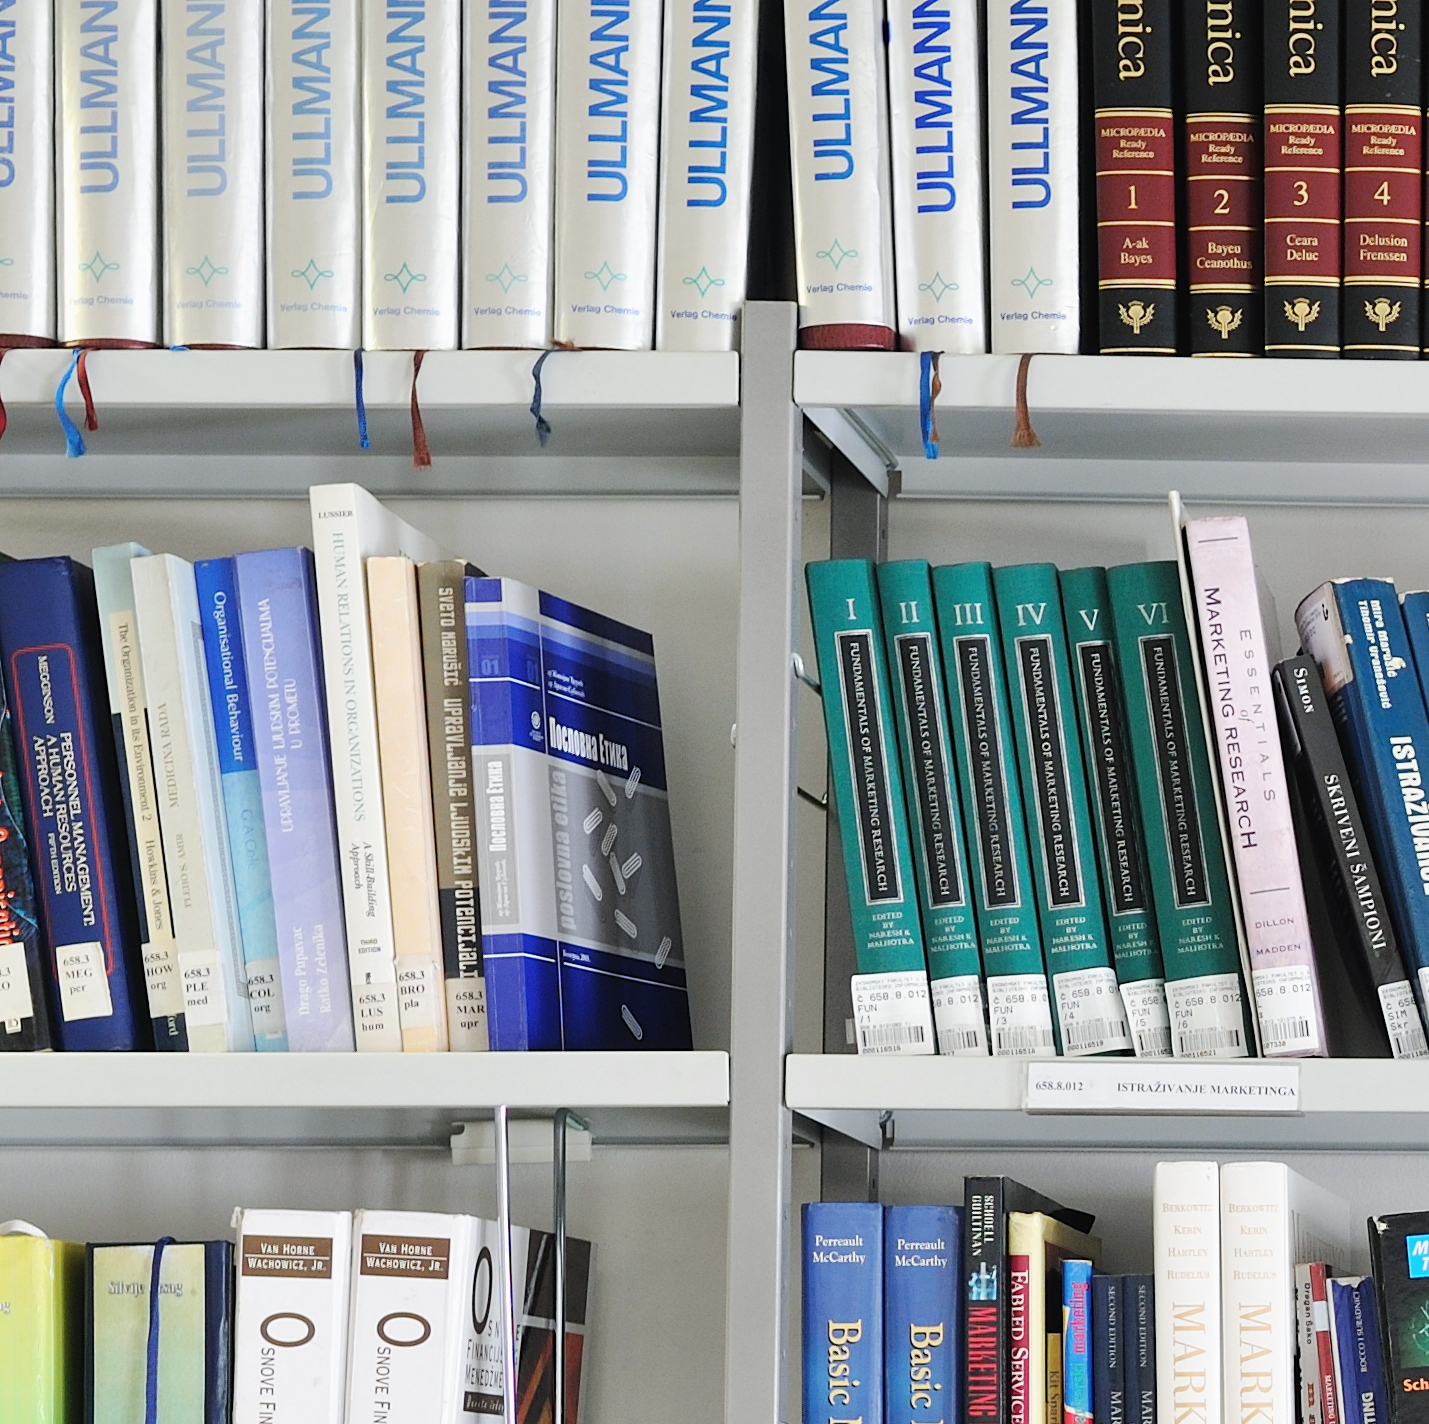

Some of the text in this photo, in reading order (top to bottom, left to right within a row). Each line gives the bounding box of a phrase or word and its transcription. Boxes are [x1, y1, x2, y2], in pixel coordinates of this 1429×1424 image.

[1112, 149, 1155, 159] Reference
[1119, 139, 1147, 150] Ready
[1128, 186, 1138, 209] 1
[1213, 190, 1230, 214] 2
[1373, 181, 1392, 206] 4
[1359, 234, 1408, 247] Delusion
[1120, 251, 1153, 265] Bayes
[1359, 249, 1408, 262] Frenssen
[806, 283, 873, 294] Verlag Chemie
[213, 591, 246, 762] Organisational Behaviour
[60, 732, 81, 820] PERSONNEL
[1152, 646, 1197, 897] FUNDAMENTALS OF MARKETING RESEARCH
[1322, 773, 1387, 951] SKRIVENI ŠAMPIONI
[1036, 1081, 1296, 1097] 658.8.012 ISTRAŽIVANJE MARKETINGA
[828, 1319, 862, 1406] Basic
[967, 1306, 998, 1418] MARKETING
